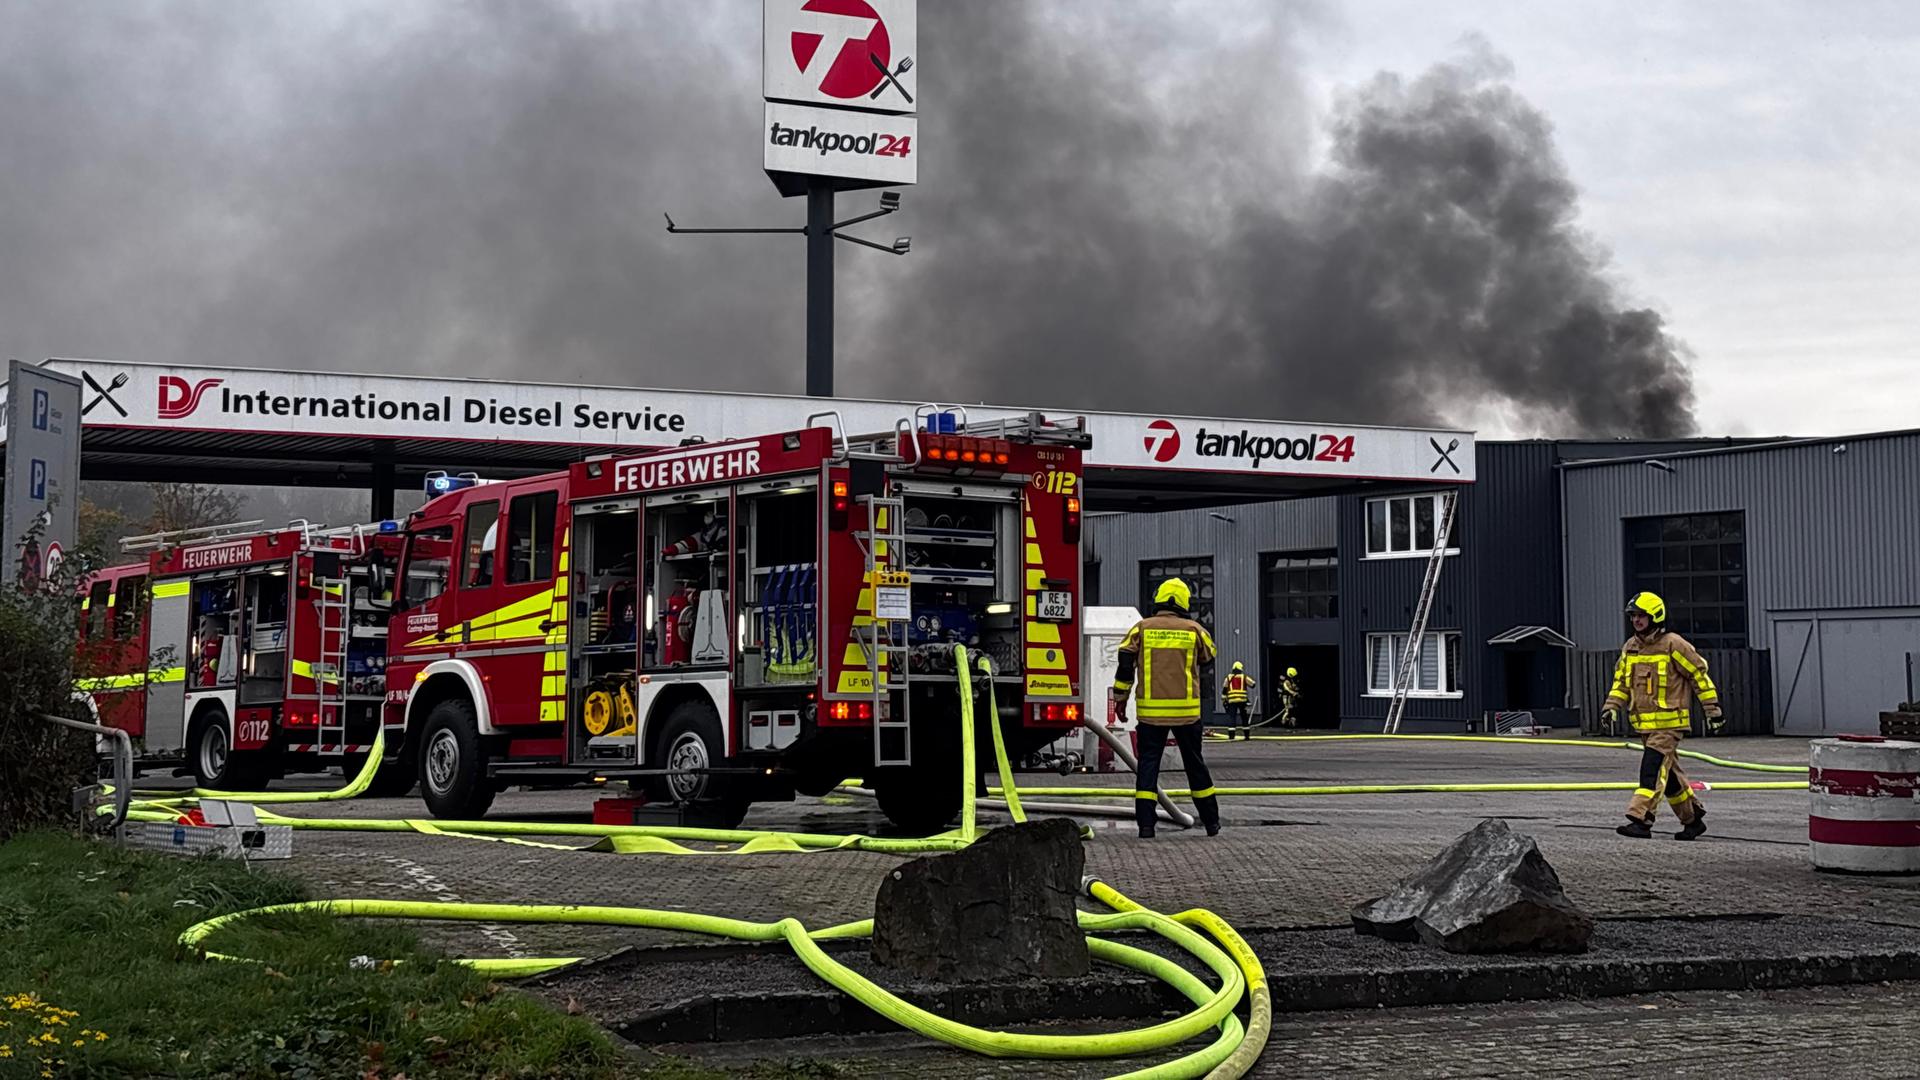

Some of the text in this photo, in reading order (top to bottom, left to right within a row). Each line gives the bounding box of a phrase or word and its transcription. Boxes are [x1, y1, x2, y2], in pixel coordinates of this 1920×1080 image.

[770, 122, 912, 158] tankpool24
[222, 388, 451, 422] International
[464, 399, 562, 427] Diesel
[574, 404, 685, 432] Service
[1196, 428, 1355, 469] tankpool24
[615, 441, 760, 492] FEUERWEHR
[1047, 471, 1076, 494] 112
[182, 540, 253, 569] FEUERWEHR
[1044, 605, 1066, 617] 6822
[1048, 592, 1060, 604] RE
[848, 678, 858, 687] LF
[249, 720, 269, 741] 112
